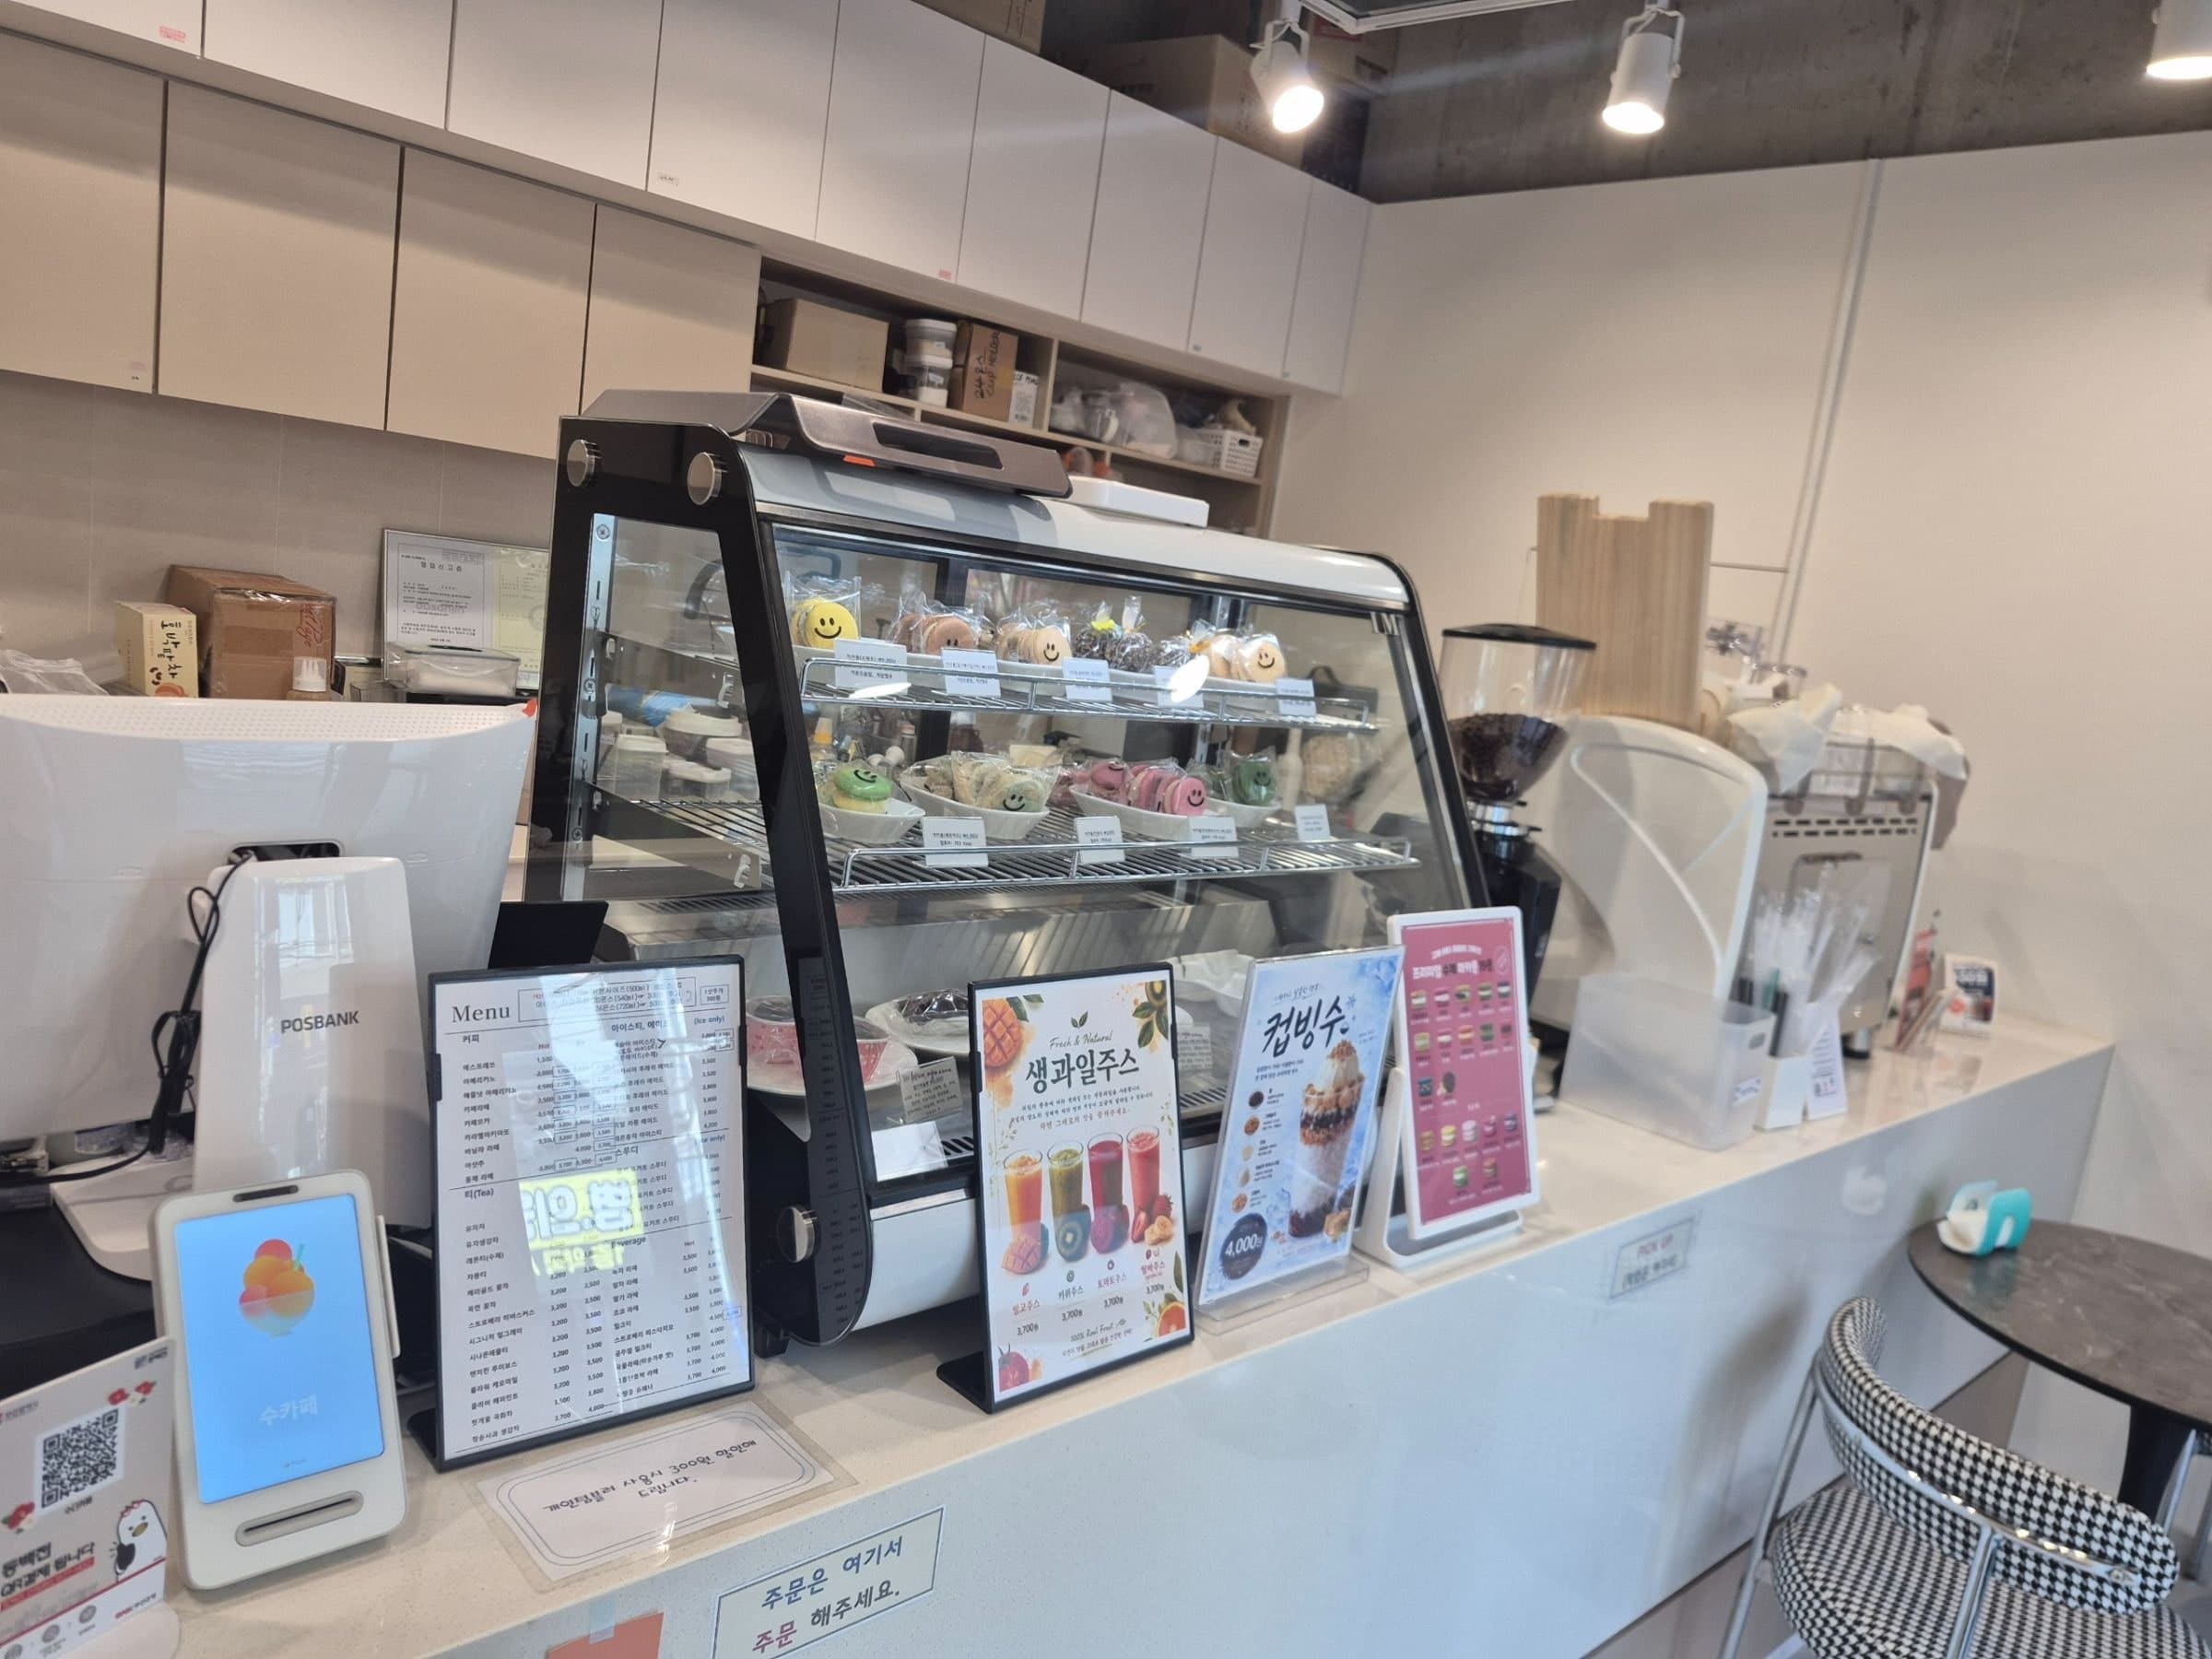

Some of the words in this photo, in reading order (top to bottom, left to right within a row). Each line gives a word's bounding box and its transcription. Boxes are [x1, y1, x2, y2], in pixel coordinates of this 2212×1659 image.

[452, 1005, 511, 1023] Menu
[708, 1015, 724, 1024] only)
[280, 1010, 360, 1035] POSBANK
[611, 1021, 645, 1031] 아이스티,
[1261, 994, 1347, 1058] 컵빙수
[463, 1034, 479, 1044] 커피
[1083, 1030, 1113, 1044] Natural
[1025, 1048, 1139, 1094] 생과일주스
[463, 1076, 495, 1084] 아메리카노
[1055, 1115, 1080, 1127] 그대로의
[616, 1146, 639, 1156] 스무디
[465, 1159, 485, 1170] 아샷추
[465, 1188, 494, 1199] 티(Tea)
[465, 1223, 486, 1232] 유자차
[466, 1236, 499, 1248] 유자생강차
[611, 1237, 646, 1249] Bverage
[465, 1252, 504, 1265] 레몬티(수제)
[1140, 1260, 1166, 1275] 딸바주스
[467, 1271, 487, 1280] 자몽티
[1097, 1273, 1127, 1289] 토마토주스
[467, 1286, 493, 1296] 메리골드
[551, 1288, 567, 1296] 3,200
[1058, 1284, 1084, 1300] 키위주스
[1145, 1282, 1165, 1295] 3,700원
[551, 1302, 567, 1312] 3,200
[584, 1295, 601, 1304] 3,500
[613, 1294, 625, 1302] 딸기
[1103, 1295, 1124, 1309] 3,700원
[613, 1308, 625, 1316] 초코
[1012, 1298, 1041, 1316] 망고주스
[551, 1318, 568, 1326] 3,200
[585, 1311, 602, 1319] 3,500
[1061, 1309, 1083, 1322] 3,700원
[614, 1320, 631, 1330] 밀크티
[1017, 1322, 1040, 1336] 3,700원
[552, 1334, 569, 1342] 3,200
[586, 1325, 602, 1335] 3,500
[635, 1343, 652, 1352] 밀크티
[492, 1361, 517, 1371] 루이보스
[258, 1394, 318, 1426] 수카페
[555, 1412, 571, 1421] 3,700
[543, 1483, 617, 1512] 개인텀블러
[623, 1469, 664, 1488] 사용시
[669, 1454, 715, 1475] 300원
[715, 1440, 758, 1459] 할인해
[638, 1476, 699, 1499] 드립니다.
[3, 1541, 52, 1578] 동백전
[1, 1562, 51, 1597] QR결제
[54, 1541, 95, 1571] 됩니다
[761, 1568, 829, 1610] 주문은
[842, 1535, 903, 1574] 여기서
[752, 1620, 797, 1654] 주문
[810, 1580, 900, 1628] 해주세요.
